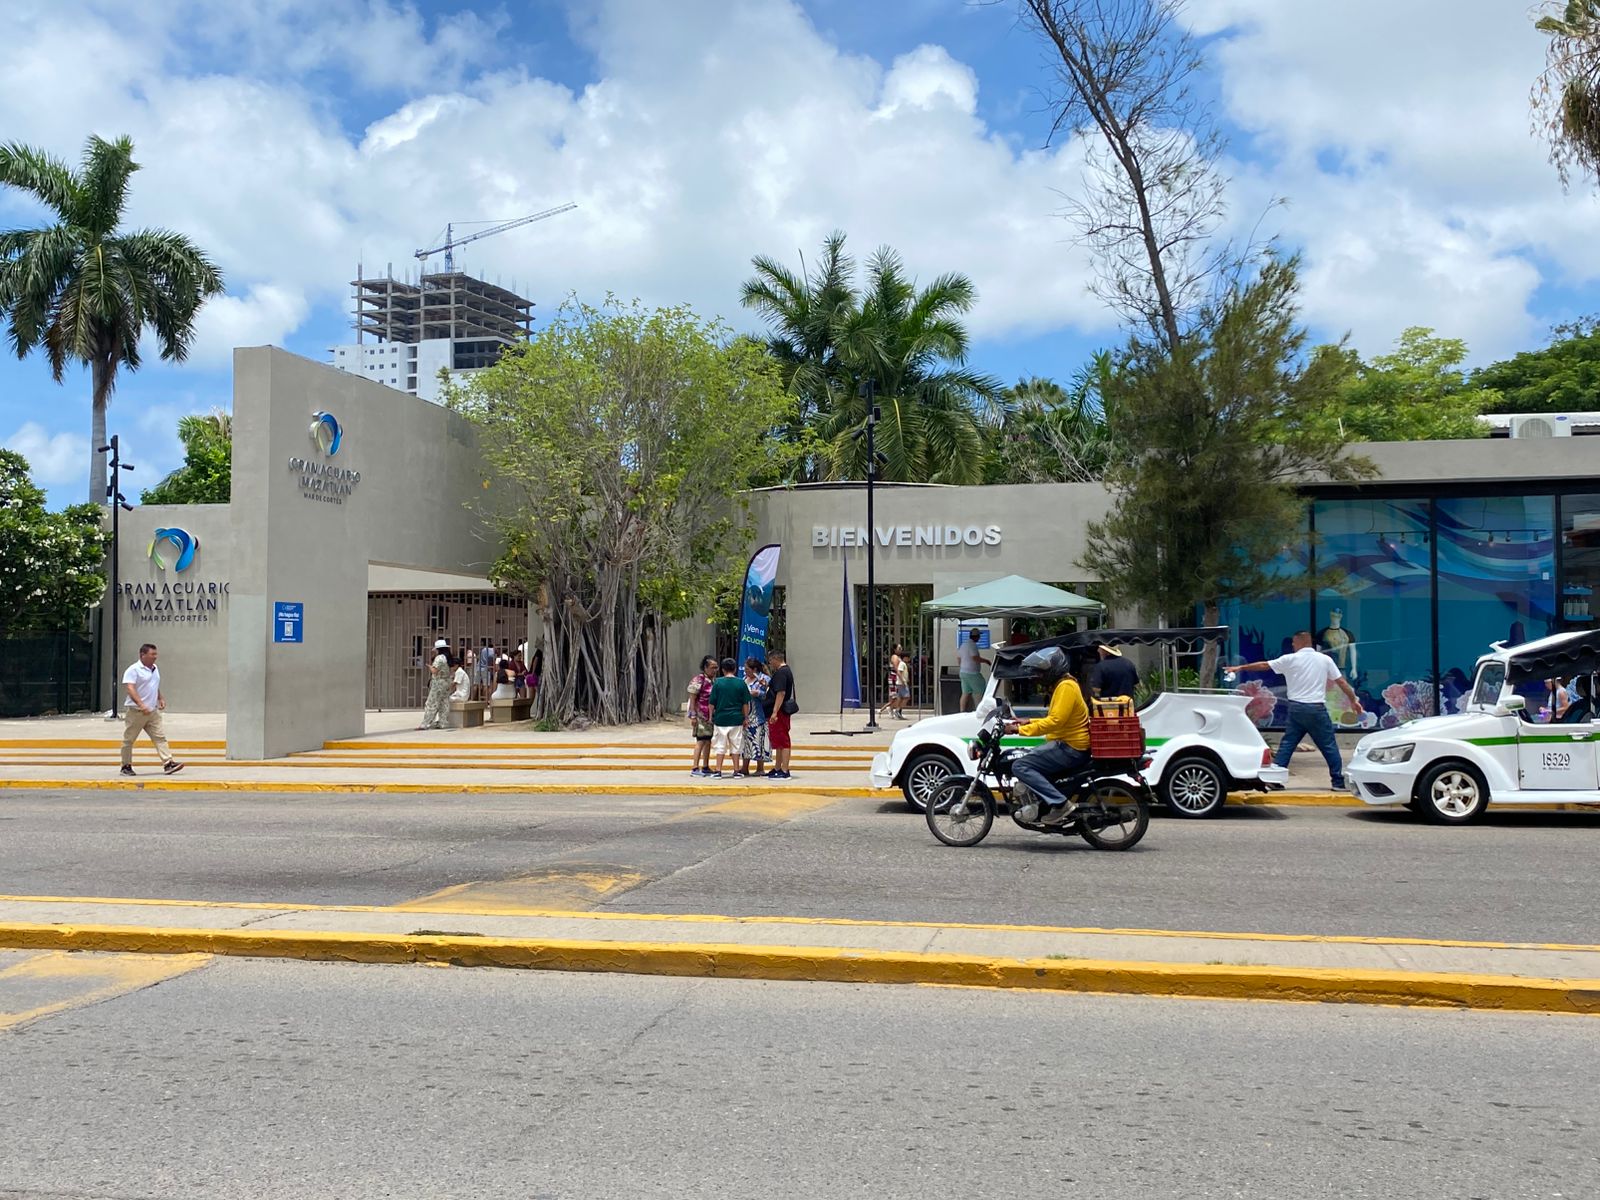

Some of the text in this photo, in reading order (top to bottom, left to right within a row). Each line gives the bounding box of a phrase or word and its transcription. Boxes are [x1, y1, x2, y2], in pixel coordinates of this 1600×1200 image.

[290, 457, 361, 483] GRAN ACUARIO
[812, 525, 1002, 548] BIENVENIDOS
[141, 614, 159, 622] MAR
[161, 614, 172, 622] DE
[1542, 752, 1571, 767] 18529
